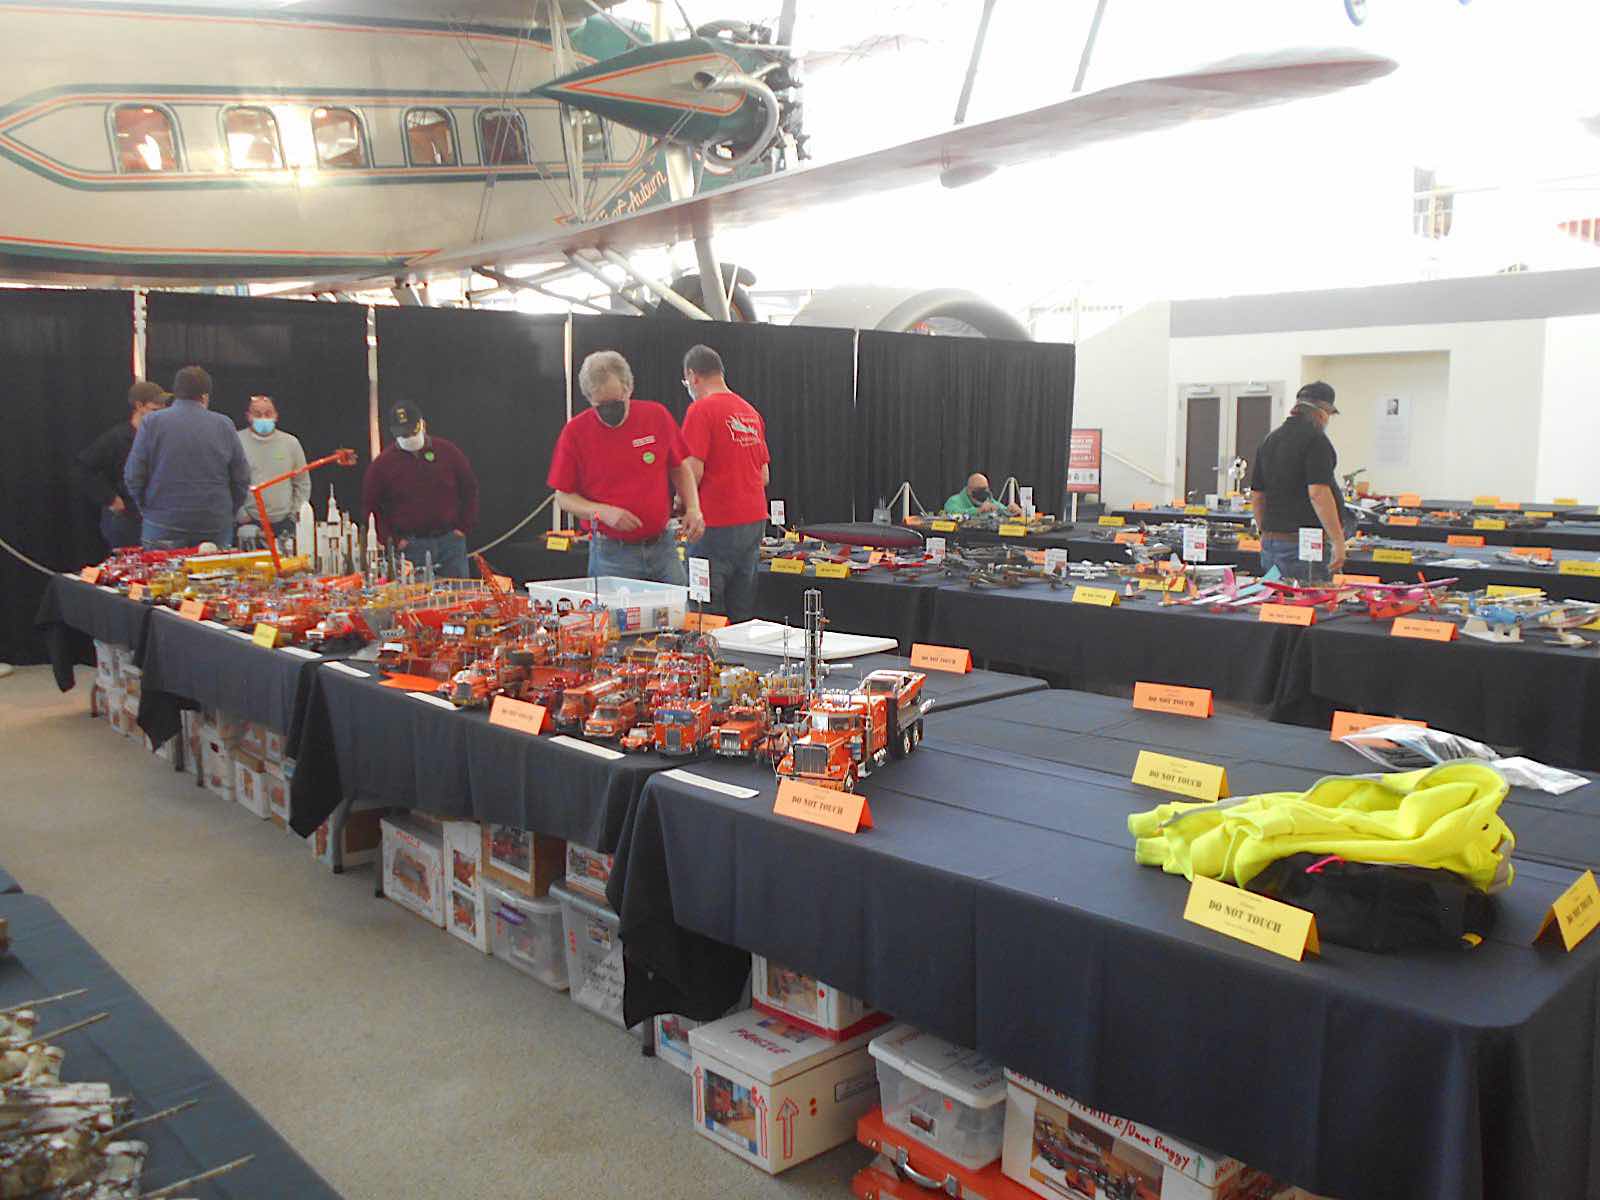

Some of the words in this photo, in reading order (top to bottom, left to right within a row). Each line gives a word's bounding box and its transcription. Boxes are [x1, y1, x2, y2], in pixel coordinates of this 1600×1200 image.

[1148, 769, 1159, 778] DO
[1161, 771, 1176, 782] NOT
[1177, 776, 1203, 788] TOUCH
[791, 795, 802, 804] DO
[803, 797, 817, 809] NOT
[819, 801, 844, 816] TOUCH
[1208, 899, 1223, 912] DO
[1225, 906, 1244, 920] NOT
[1246, 912, 1283, 934] TOUCH
